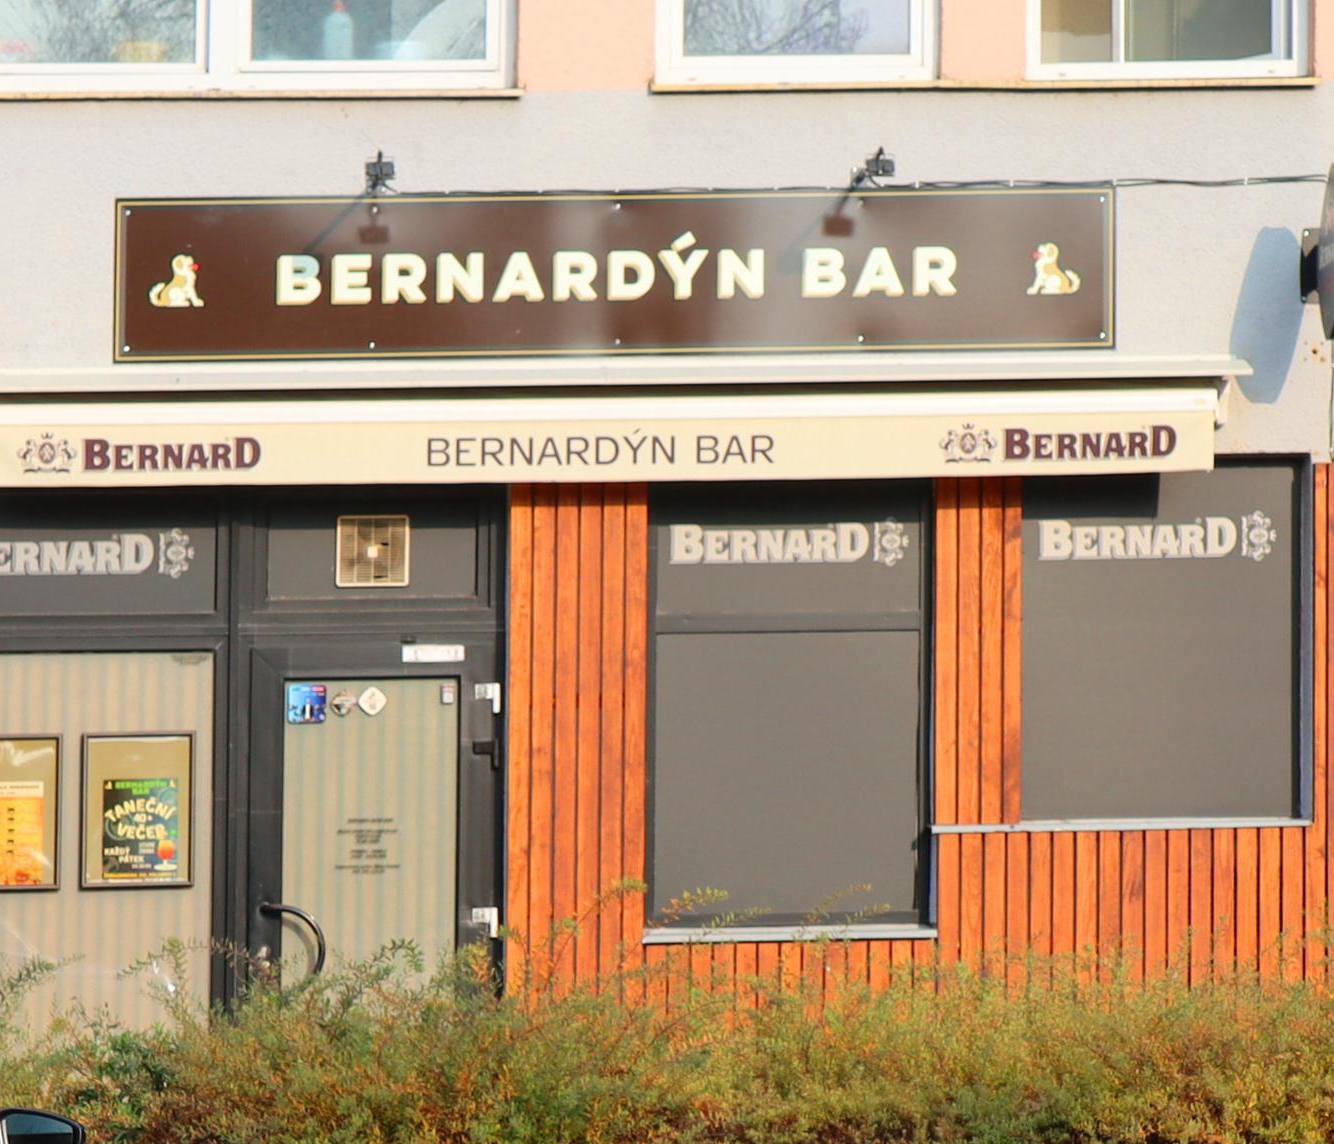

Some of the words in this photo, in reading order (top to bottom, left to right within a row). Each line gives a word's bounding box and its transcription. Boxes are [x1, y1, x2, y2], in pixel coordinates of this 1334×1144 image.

[276, 230, 765, 306] BERNARDÝN
[802, 246, 957, 298] BAR
[82, 437, 261, 472] BERNARD
[426, 428, 676, 467] BERNARDÝN
[695, 435, 775, 465] BAR
[1003, 425, 1177, 461] BERNARD
[668, 522, 870, 565] BERNARD
[1038, 516, 1238, 561] BERNARD
[104, 796, 176, 822] TANEČNÍ
[117, 823, 168, 840] VEČER
